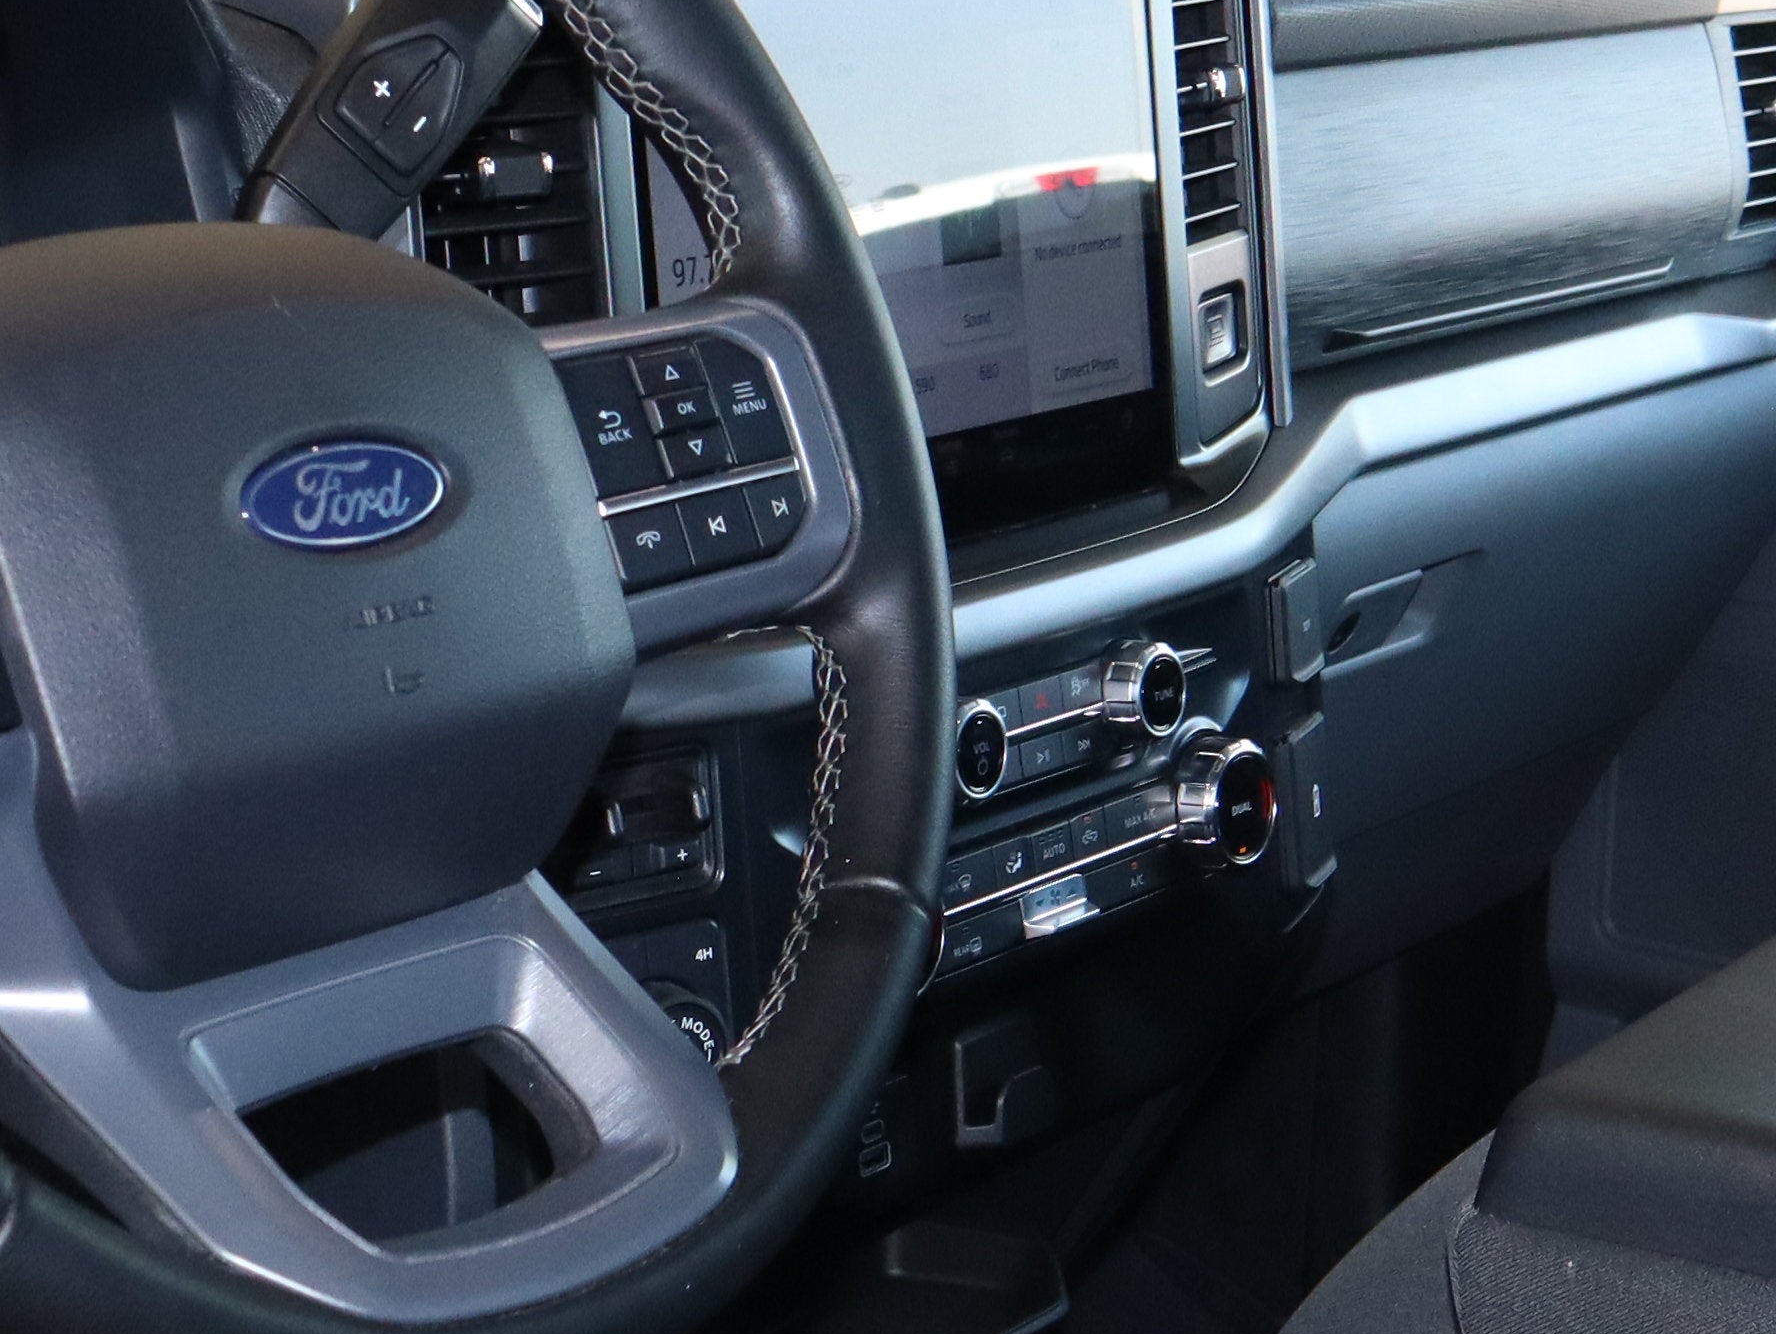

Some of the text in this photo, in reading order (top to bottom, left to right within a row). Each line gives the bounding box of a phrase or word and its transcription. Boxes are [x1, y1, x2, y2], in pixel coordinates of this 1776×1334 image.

[1035, 234, 1122, 262] No device connected
[963, 310, 991, 329] Sound
[1055, 357, 1120, 382] Connect Phone
[677, 400, 696, 415] OK
[732, 398, 768, 416] MENU
[597, 429, 633, 446] BACK
[293, 459, 411, 533] Ford
[973, 742, 991, 755] VOL
[1232, 800, 1252, 816] DUAL
[1042, 843, 1066, 860] AUTO
[1130, 873, 1145, 888] A/C
[694, 947, 713, 962] 4H
[680, 1016, 715, 1052] MODE
